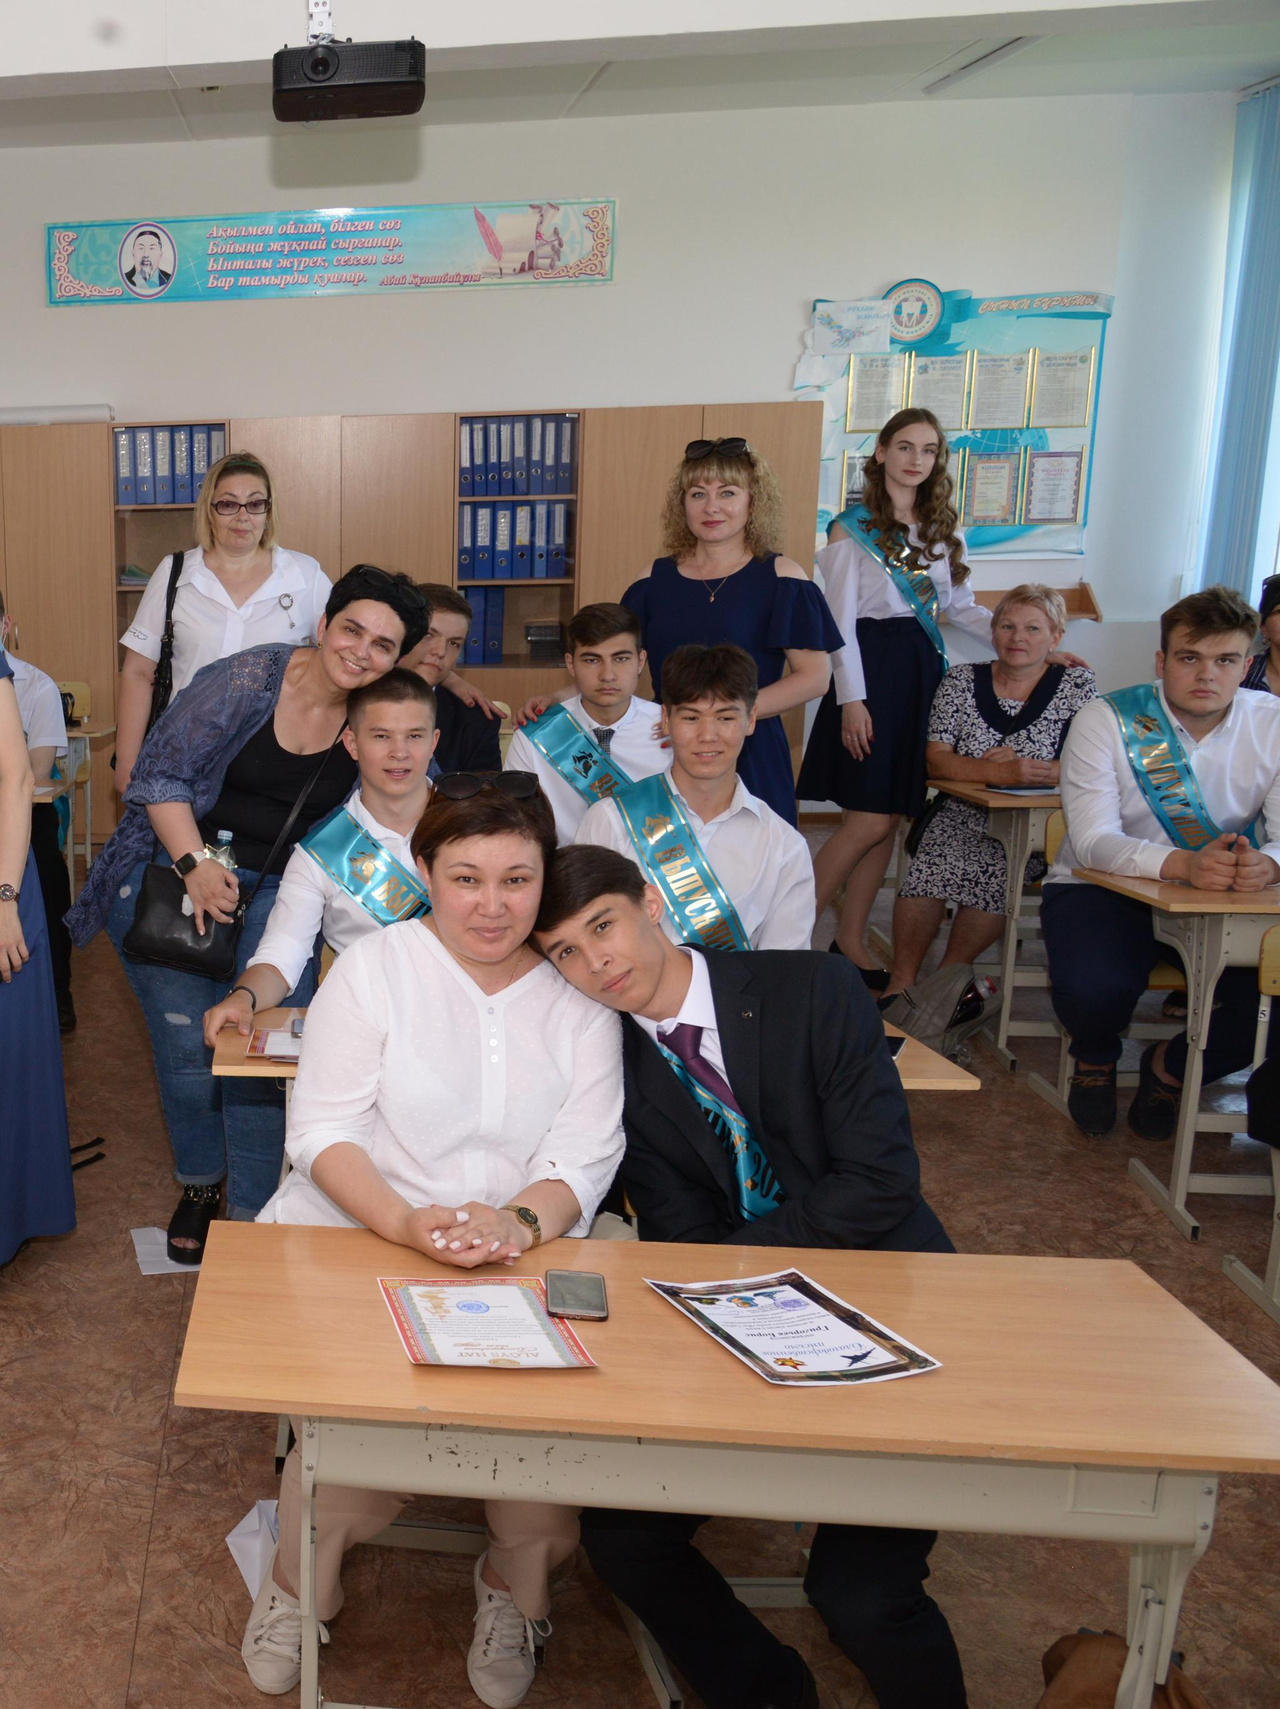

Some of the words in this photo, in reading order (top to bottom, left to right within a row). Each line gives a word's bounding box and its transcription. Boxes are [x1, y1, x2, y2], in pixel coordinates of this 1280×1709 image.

[206, 224, 274, 240] Ақылмен
[278, 223, 326, 237] ойлап,
[330, 219, 375, 235] білген
[379, 219, 401, 232] сөз
[206, 240, 264, 257] Бойыңа
[330, 236, 402, 253] сырғанар.
[207, 257, 273, 272] Ынталы
[276, 256, 329, 272] жүрек,
[333, 254, 377, 269] сезген
[381, 252, 404, 265] сөз
[206, 275, 235, 290] Бар
[238, 272, 309, 287] тамырды
[313, 271, 367, 286] қуалар.
[979, 298, 1031, 314] СЫНЫП
[1259, 1009, 1267, 1019] 5
